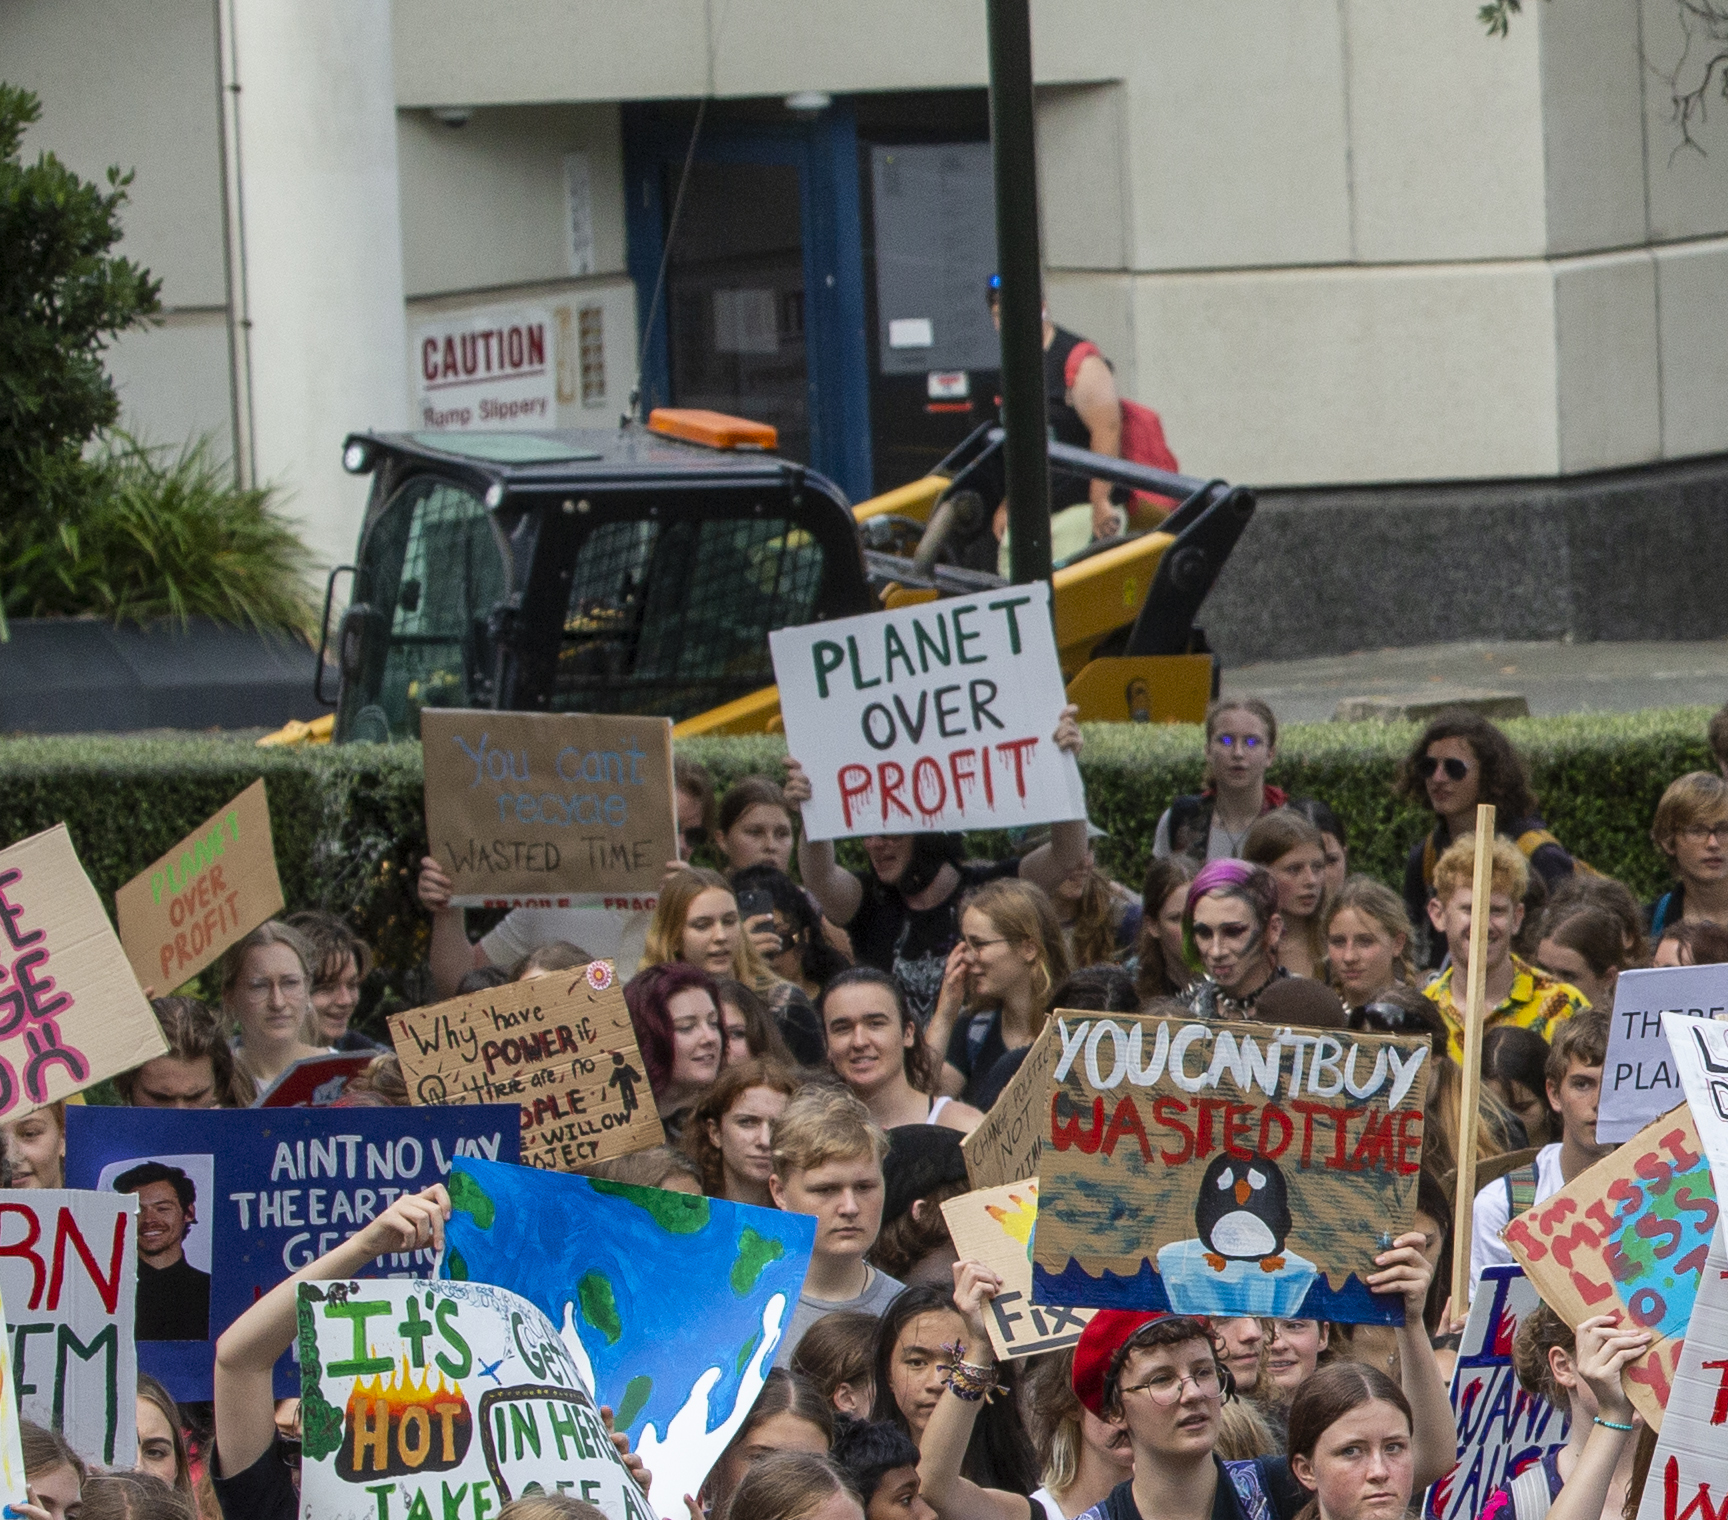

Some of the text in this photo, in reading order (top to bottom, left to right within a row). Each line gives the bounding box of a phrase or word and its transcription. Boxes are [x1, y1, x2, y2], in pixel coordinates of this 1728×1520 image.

[422, 323, 545, 381] CAUTION
[423, 397, 547, 427] Ramp Slippery
[811, 596, 1031, 698] PLANET
[861, 679, 1004, 750] OVER
[453, 733, 531, 788] You
[837, 736, 1039, 830] PROFIT
[497, 793, 628, 827] recycle
[150, 810, 239, 906] PLANET
[445, 835, 653, 872] WASTED TIME
[169, 864, 227, 928] OVER
[159, 891, 239, 980] PROFIT
[408, 1004, 545, 1063] Why have
[481, 1024, 579, 1076] POWER
[1053, 1016, 1170, 1090] YOU
[1307, 1034, 1428, 1110] BUY
[531, 1069, 556, 1088] are
[571, 1058, 596, 1080] no
[520, 1089, 587, 1131] OPLE
[540, 1109, 632, 1146] WILLOW
[1001, 1096, 1032, 1168] NOT
[1049, 1091, 1424, 1176] WASTED TIME
[271, 1134, 363, 1181] AINT
[367, 1136, 423, 1180] NO
[229, 1189, 304, 1230] THE
[1552, 1128, 1701, 1269] MISSI
[1569, 1187, 1720, 1306] LESS
[353, 1397, 622, 1472] HOT IN HERE
